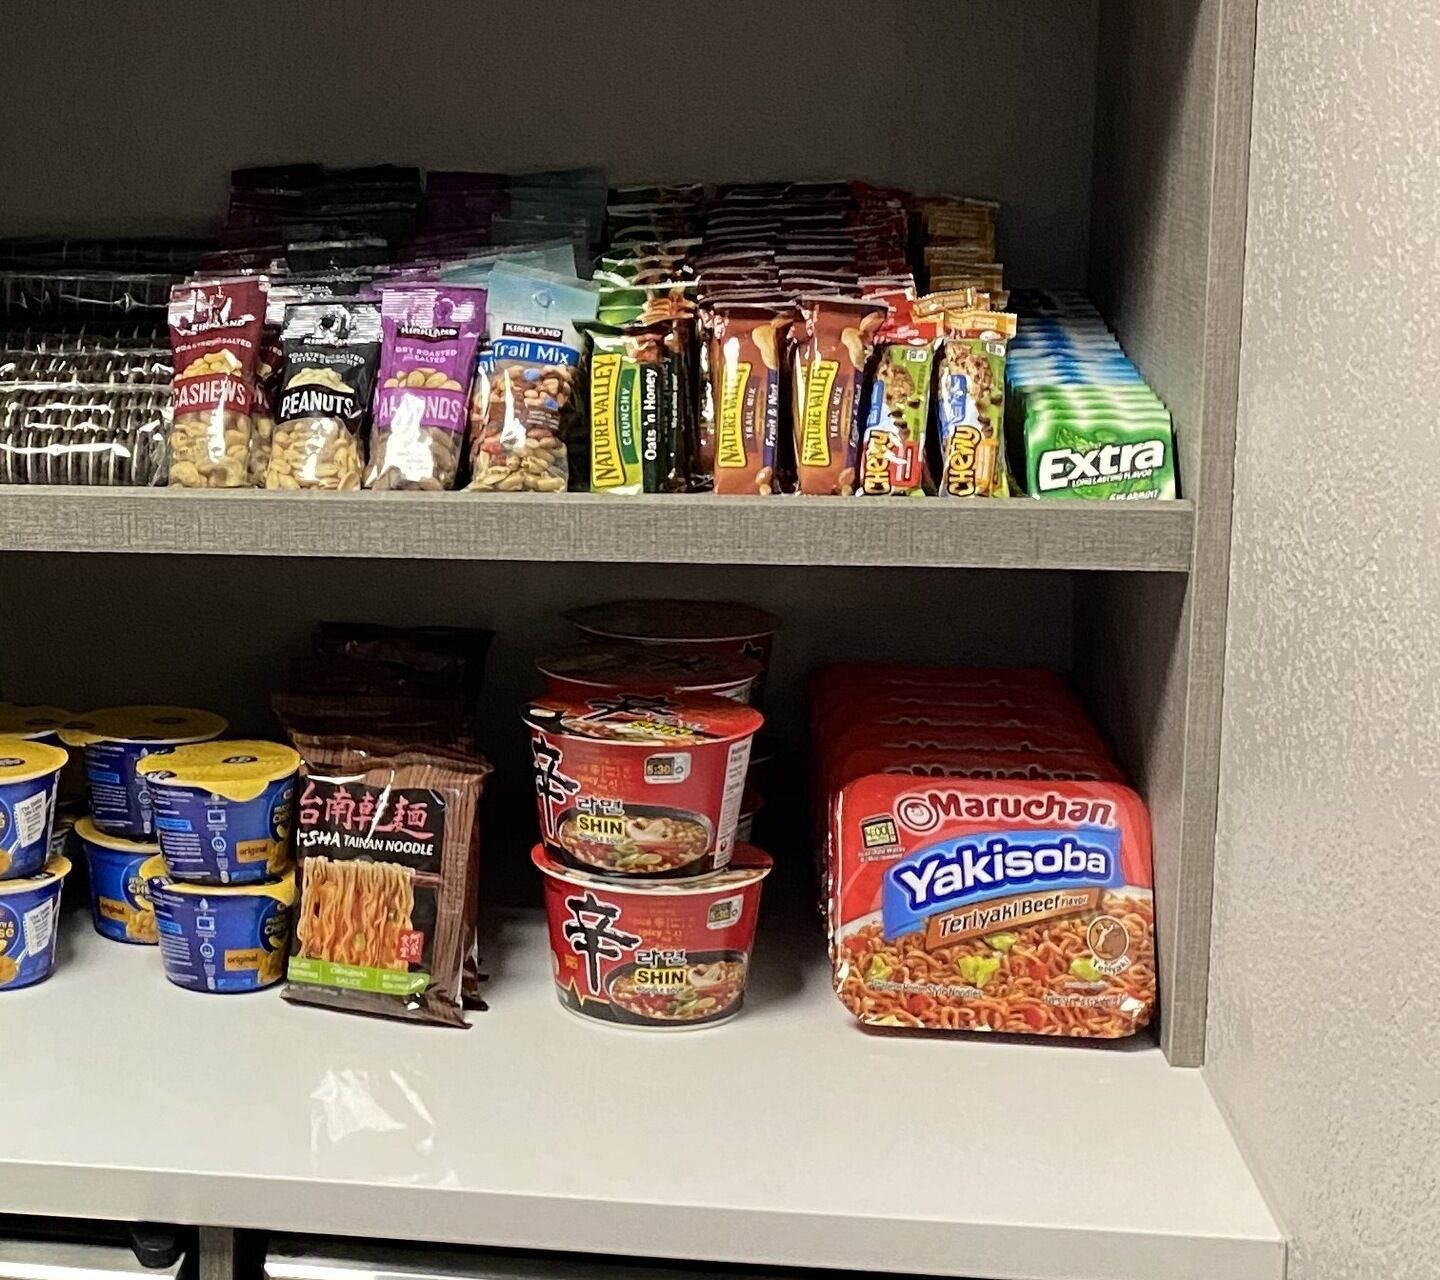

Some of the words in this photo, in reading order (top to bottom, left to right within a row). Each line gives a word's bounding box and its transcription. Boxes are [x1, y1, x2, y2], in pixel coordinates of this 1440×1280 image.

[222, 337, 253, 349] SALTED
[505, 324, 562, 338] KIRKLAND
[396, 346, 413, 355] DRY
[417, 348, 458, 357] ROASTED
[495, 342, 529, 358] Trail
[536, 344, 569, 365] Mix
[173, 375, 246, 410] CASHEWS
[594, 357, 618, 419] VALLEY
[643, 369, 658, 411] Honey
[281, 390, 354, 419] PEANUTS
[621, 388, 632, 446] CRUNCHY
[745, 408, 755, 440] TRAIL
[765, 420, 777, 448] Fruit
[807, 410, 826, 462] NATURE
[594, 421, 620, 482] NATURE
[644, 428, 658, 461] Oats
[721, 420, 743, 463] NATURE
[1039, 440, 1165, 491] Extra
[532, 731, 582, 839] 辛
[576, 795, 625, 816] 라면
[929, 792, 1112, 826] Maruchan
[579, 815, 623, 835] SHIN
[240, 843, 267, 856] original
[343, 833, 384, 853] TAINAN
[385, 839, 434, 857] NOODLE
[901, 839, 1107, 904] Yakisoba
[939, 902, 1019, 938] Teriyaki
[1022, 894, 1061, 919] Beef
[1062, 894, 1089, 908] Flavor
[565, 891, 642, 996] 辛
[635, 950, 688, 967] 라면
[227, 954, 258, 965] original
[1092, 958, 1130, 975] Teriyaki
[637, 969, 685, 985] SHIN
[949, 988, 984, 1000] Noodles
